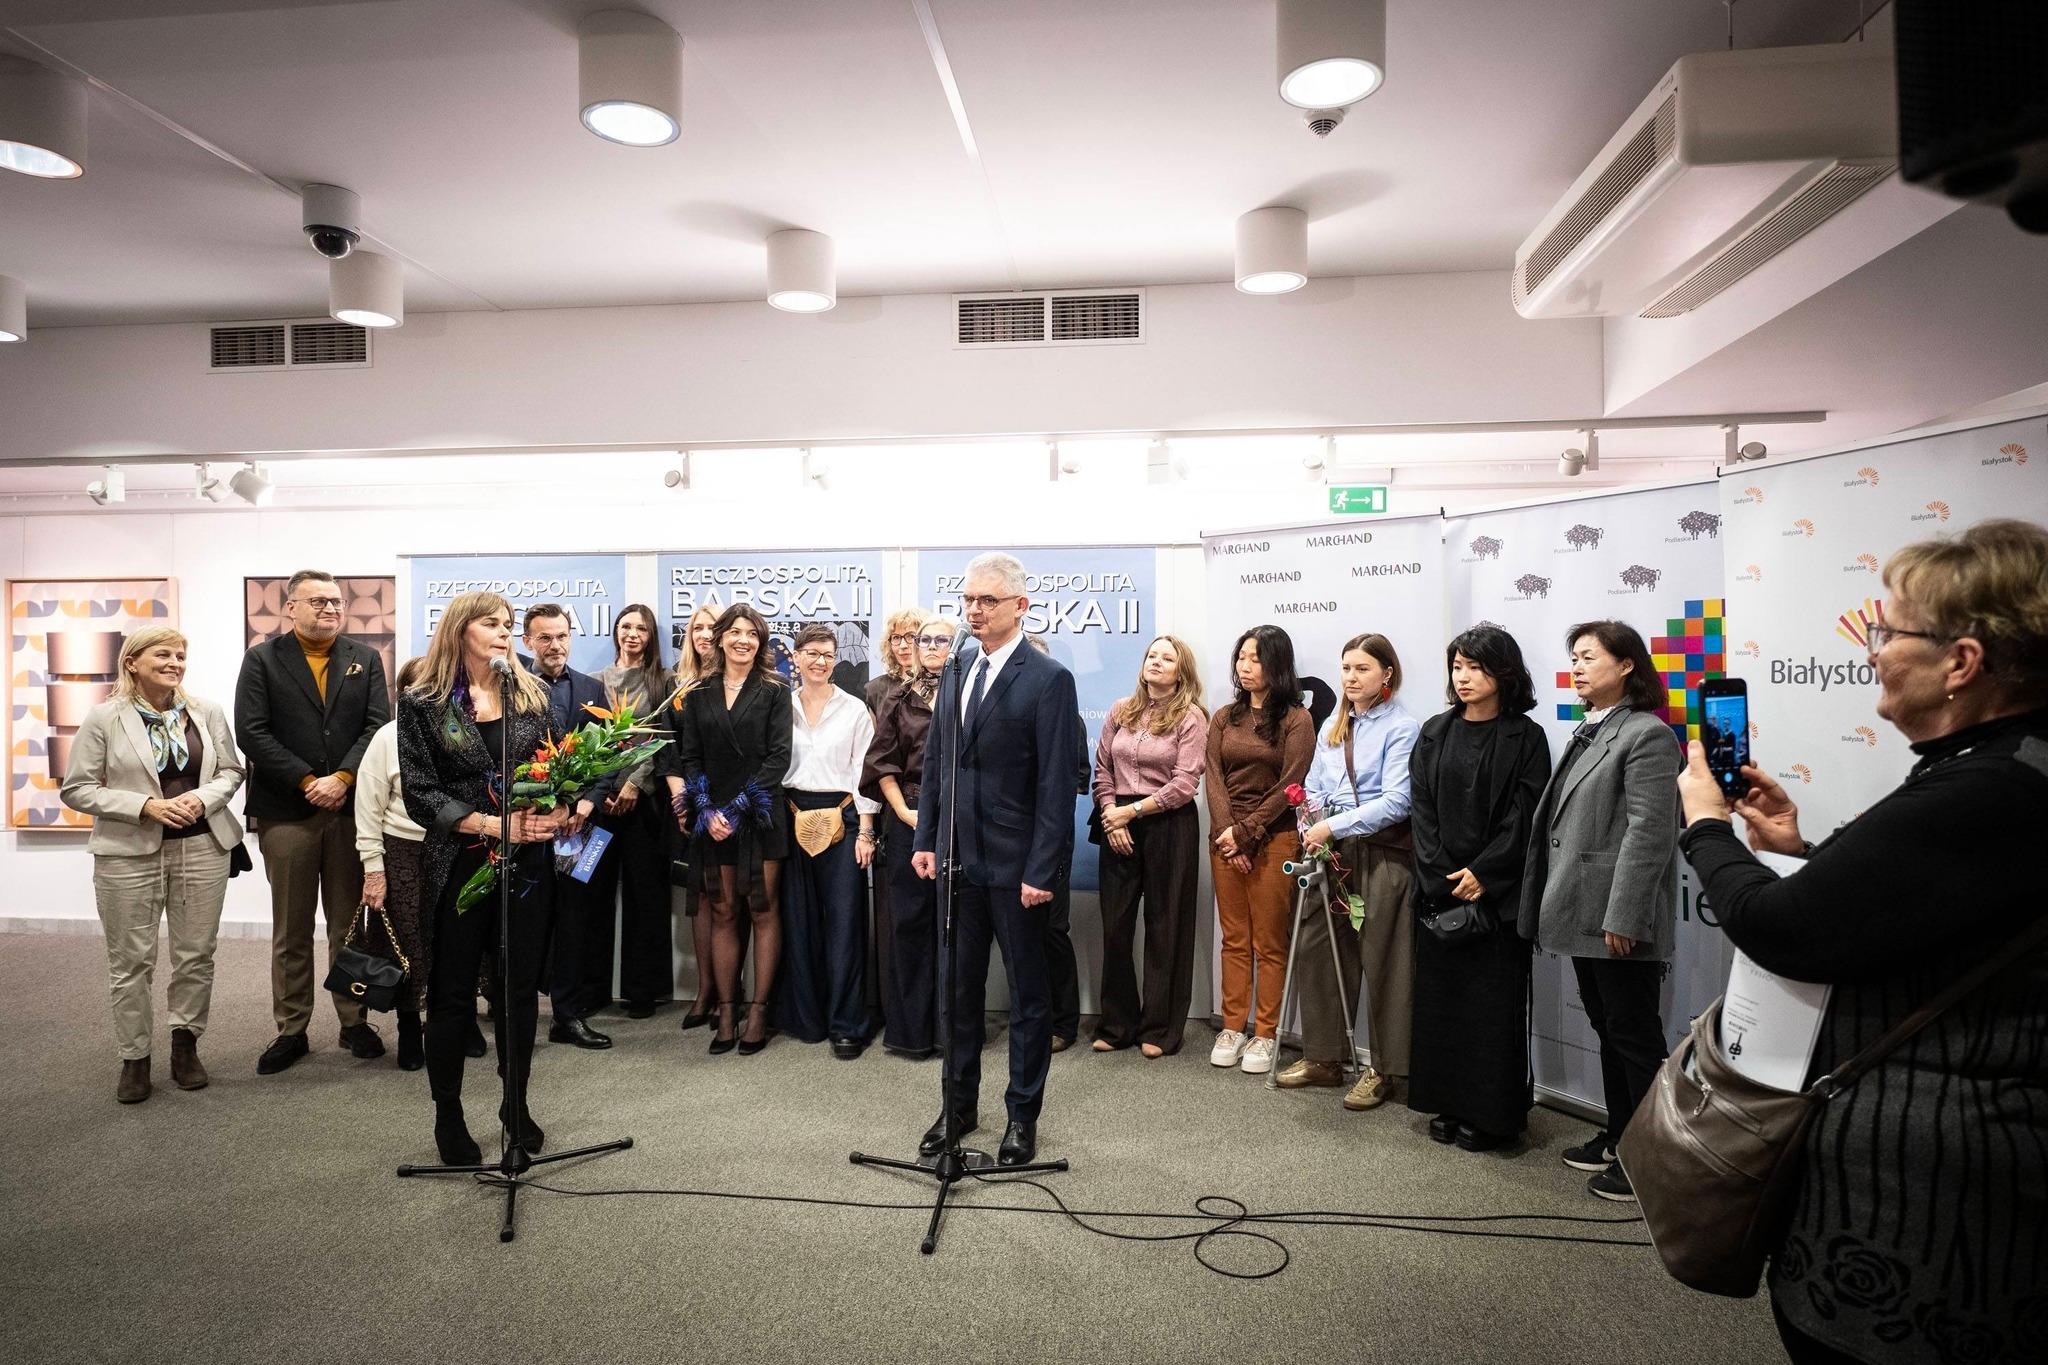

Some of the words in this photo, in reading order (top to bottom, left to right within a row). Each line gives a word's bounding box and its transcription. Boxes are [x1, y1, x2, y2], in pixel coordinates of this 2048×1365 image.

[1981, 455, 2013, 466] Białystok
[1212, 541, 1271, 556] MARCHAND
[1305, 533, 1373, 548] MARCHAND
[671, 565, 871, 585] RZECZPOSPOLITA
[1240, 571, 1302, 585] MARCHAND
[1351, 562, 1422, 578] MARCHAND
[935, 573, 1137, 594] RZOSPOLITA
[851, 584, 873, 617] II
[1273, 601, 1337, 614] MARCHAND
[592, 603, 611, 637] II
[1118, 598, 1140, 633] II
